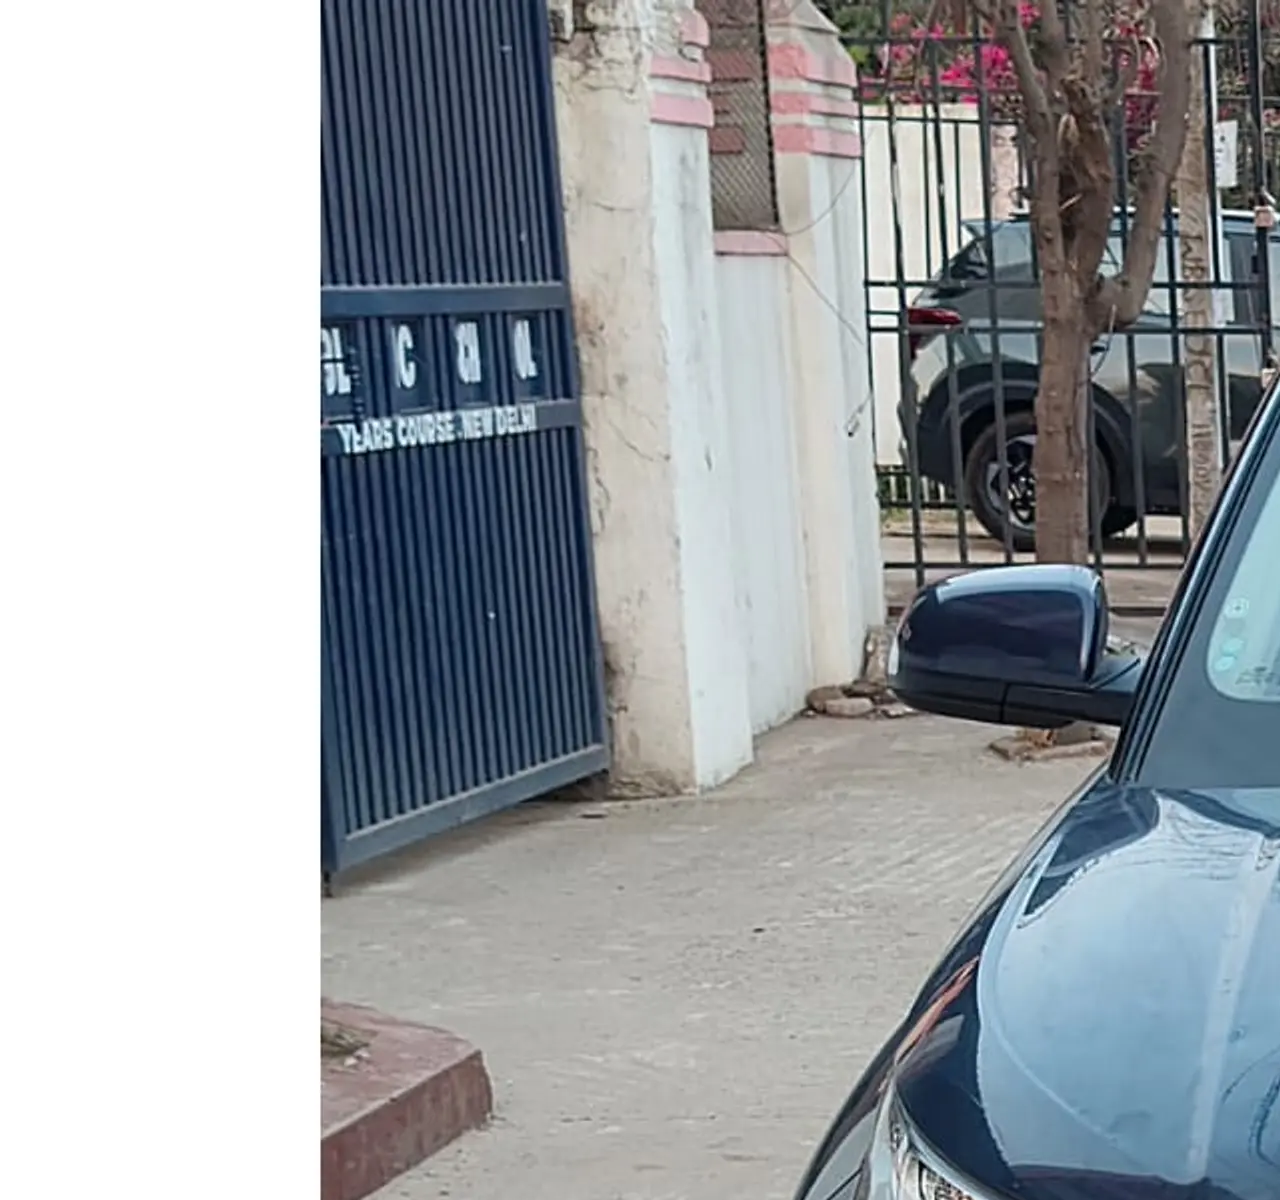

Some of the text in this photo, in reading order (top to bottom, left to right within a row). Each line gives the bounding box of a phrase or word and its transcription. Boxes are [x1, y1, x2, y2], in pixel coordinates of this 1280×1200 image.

[335, 416, 394, 454] YEARS
[395, 411, 456, 447] COURSE
[494, 403, 538, 435] DELHI
